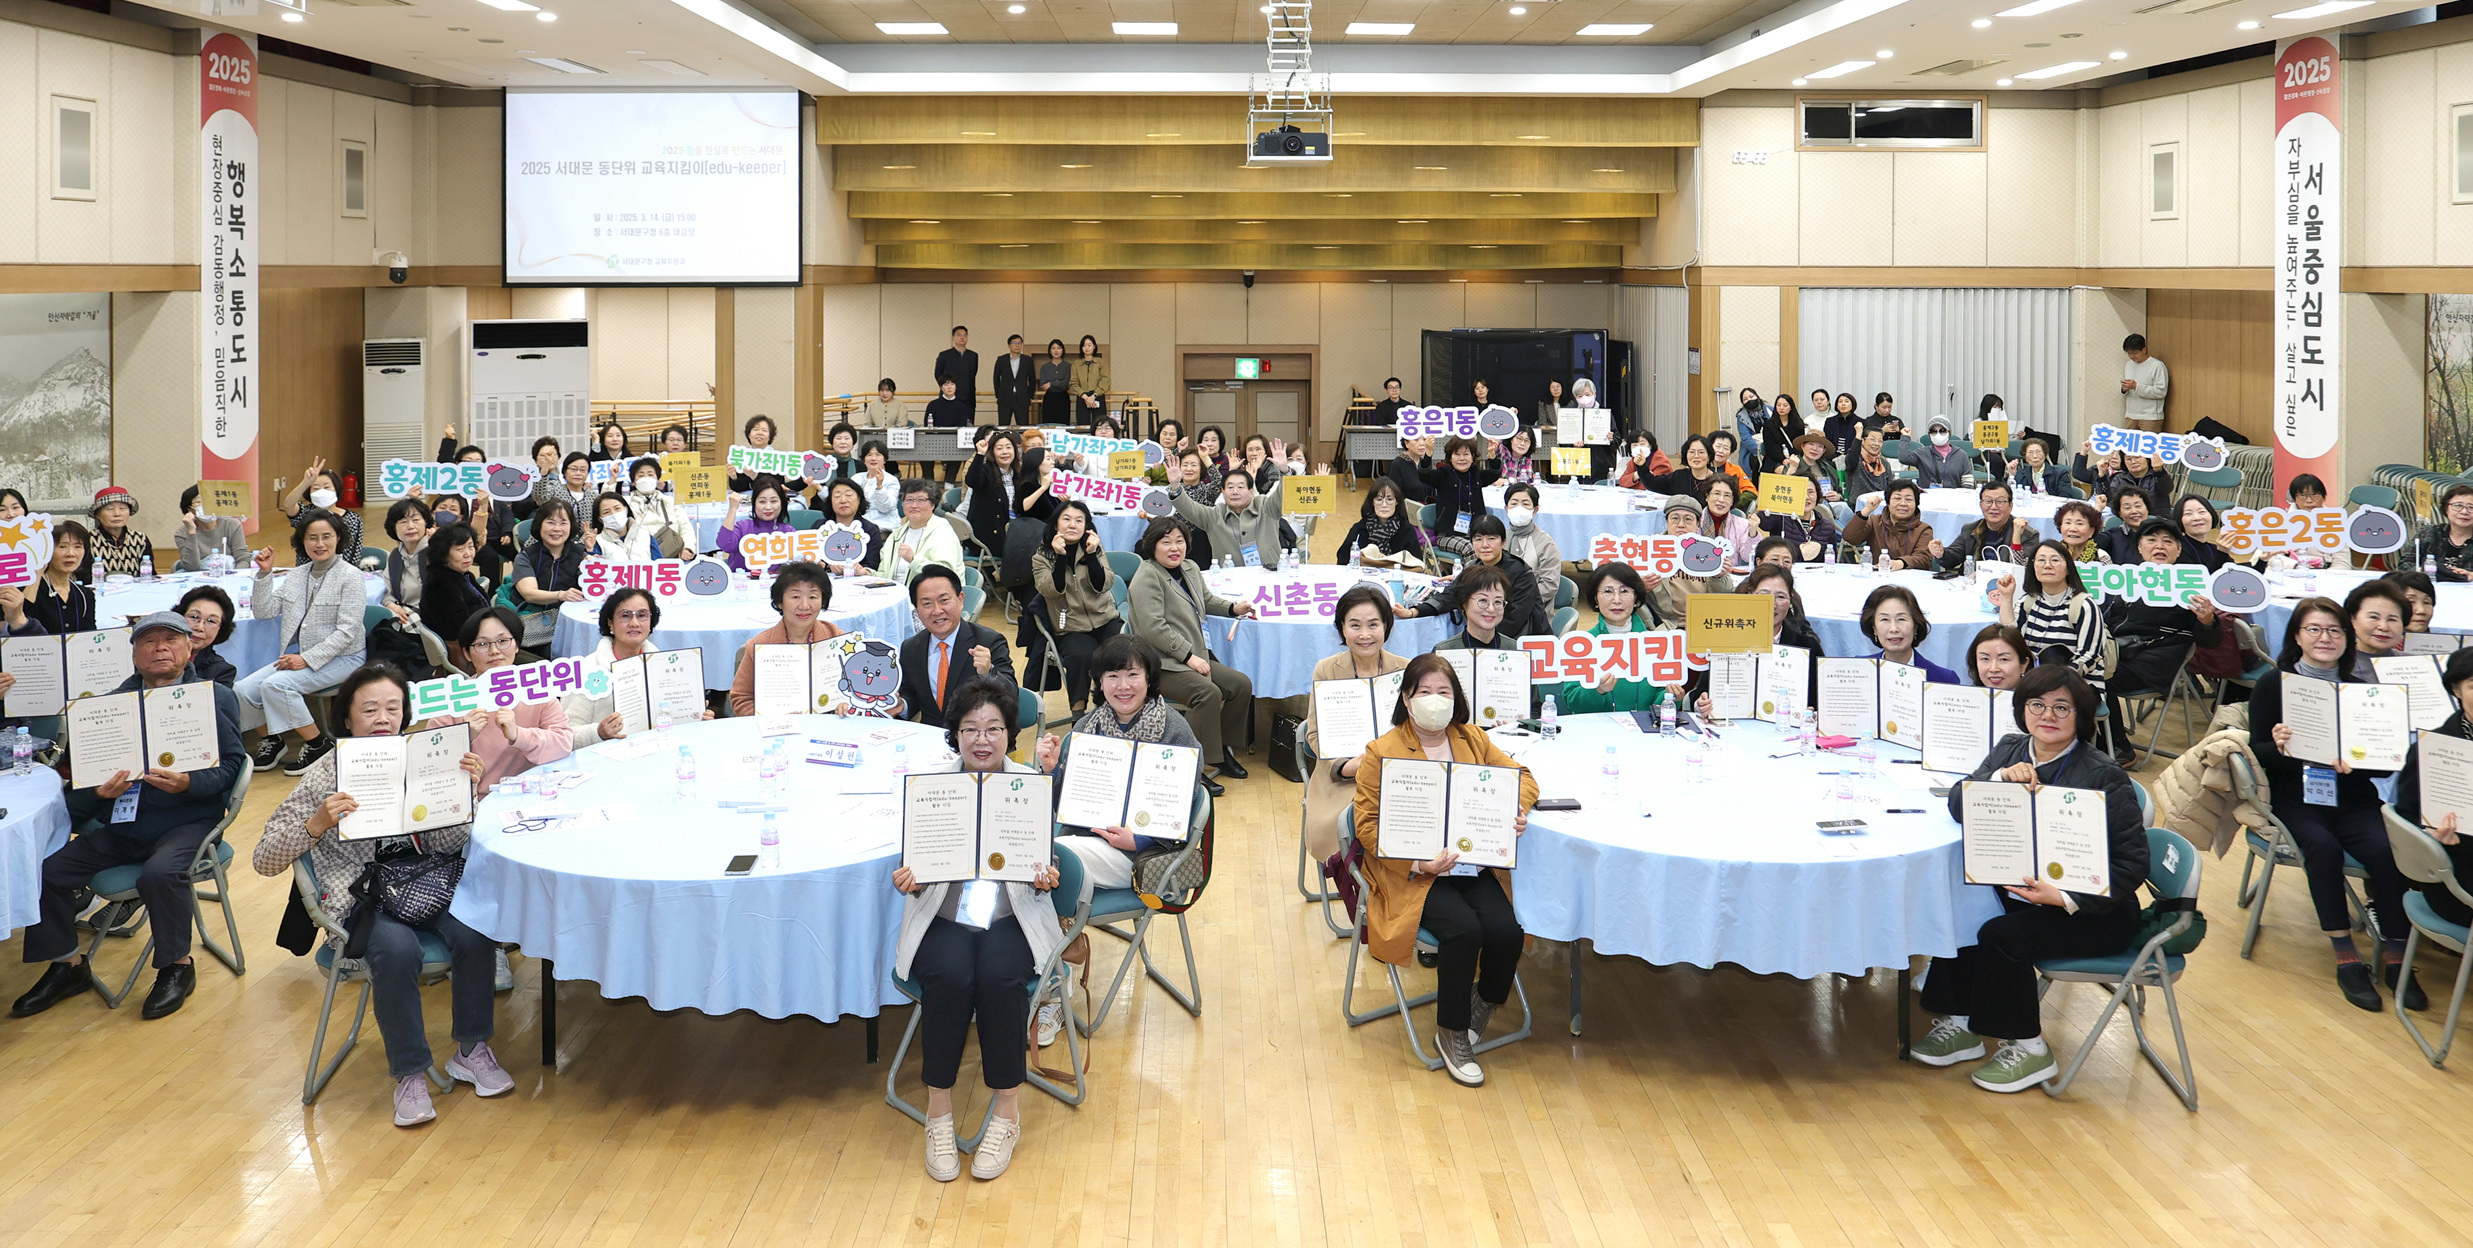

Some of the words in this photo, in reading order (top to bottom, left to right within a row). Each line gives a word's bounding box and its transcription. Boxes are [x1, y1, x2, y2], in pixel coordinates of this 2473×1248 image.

[209, 52, 250, 84] 2025
[2284, 56, 2331, 88] 2025
[521, 162, 551, 175] 2025
[556, 161, 593, 176] 서대문
[598, 161, 636, 176] 동단위
[641, 160, 787, 176] 교육지킴이[edu-keeper]
[662, 146, 684, 156] 2025
[758, 146, 784, 156] 서대문
[212, 135, 222, 226] 현장중심
[2286, 136, 2302, 226] 자부심을
[677, 213, 696, 222] 15:00
[2285, 342, 2296, 384] 살고
[214, 346, 228, 438] 믿음직한
[1400, 409, 1476, 436] 홍은1동
[2285, 394, 2296, 437] 싶은
[2093, 426, 2180, 461] 홍제3동
[384, 463, 484, 496] 홍제2동
[730, 448, 802, 476] 북가좌1동
[1053, 472, 1141, 510] 남가좌1동
[1299, 496, 1318, 504] 신촌동
[2227, 511, 2345, 550] 홍은2동
[744, 534, 820, 566] 연희동
[1593, 538, 1678, 574] 충현동
[583, 562, 682, 596] 홍제1동
[2076, 566, 2206, 604] 북아현동
[1252, 582, 1340, 617] 신촌동
[1703, 618, 1756, 630] 신규위촉자
[1522, 634, 1709, 684] 교육지킴
[409, 678, 478, 714] 드는
[490, 660, 582, 707] 동단위
